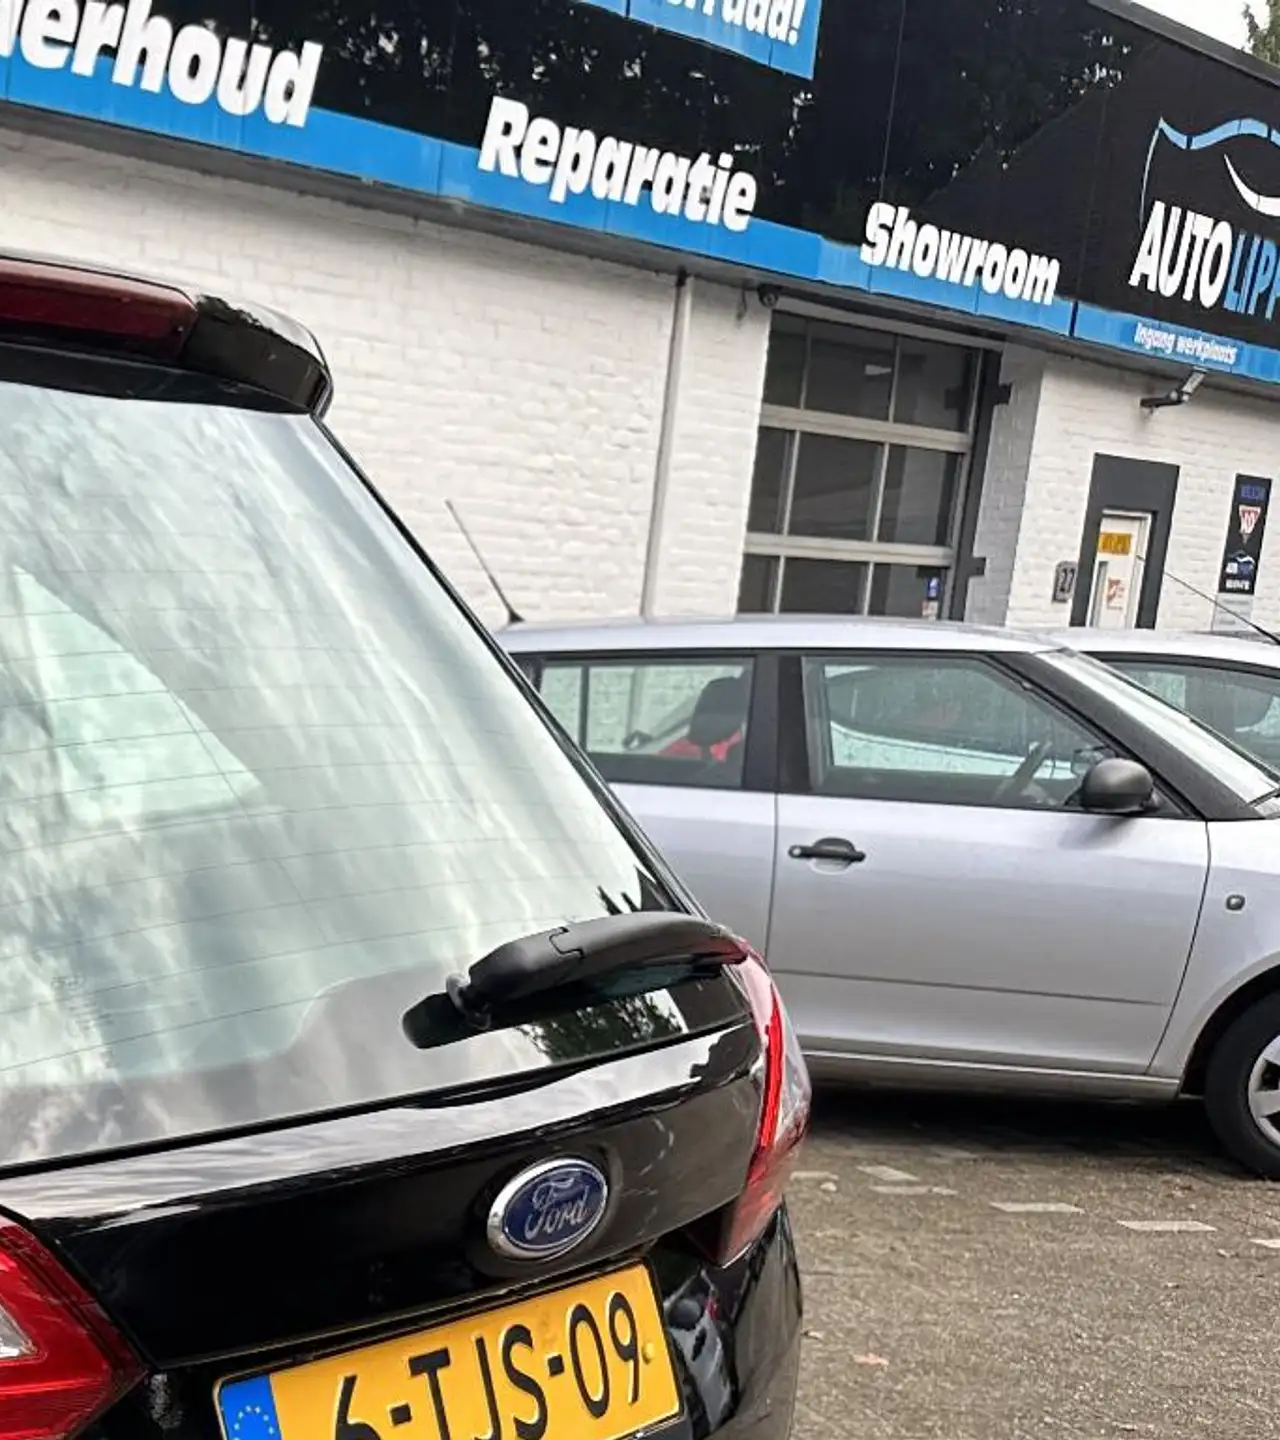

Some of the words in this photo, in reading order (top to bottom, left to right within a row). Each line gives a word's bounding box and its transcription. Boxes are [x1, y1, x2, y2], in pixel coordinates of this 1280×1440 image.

[478, 95, 757, 232] Reparatie
[860, 202, 1060, 305] Showroom
[524, 1176, 590, 1240] Ford
